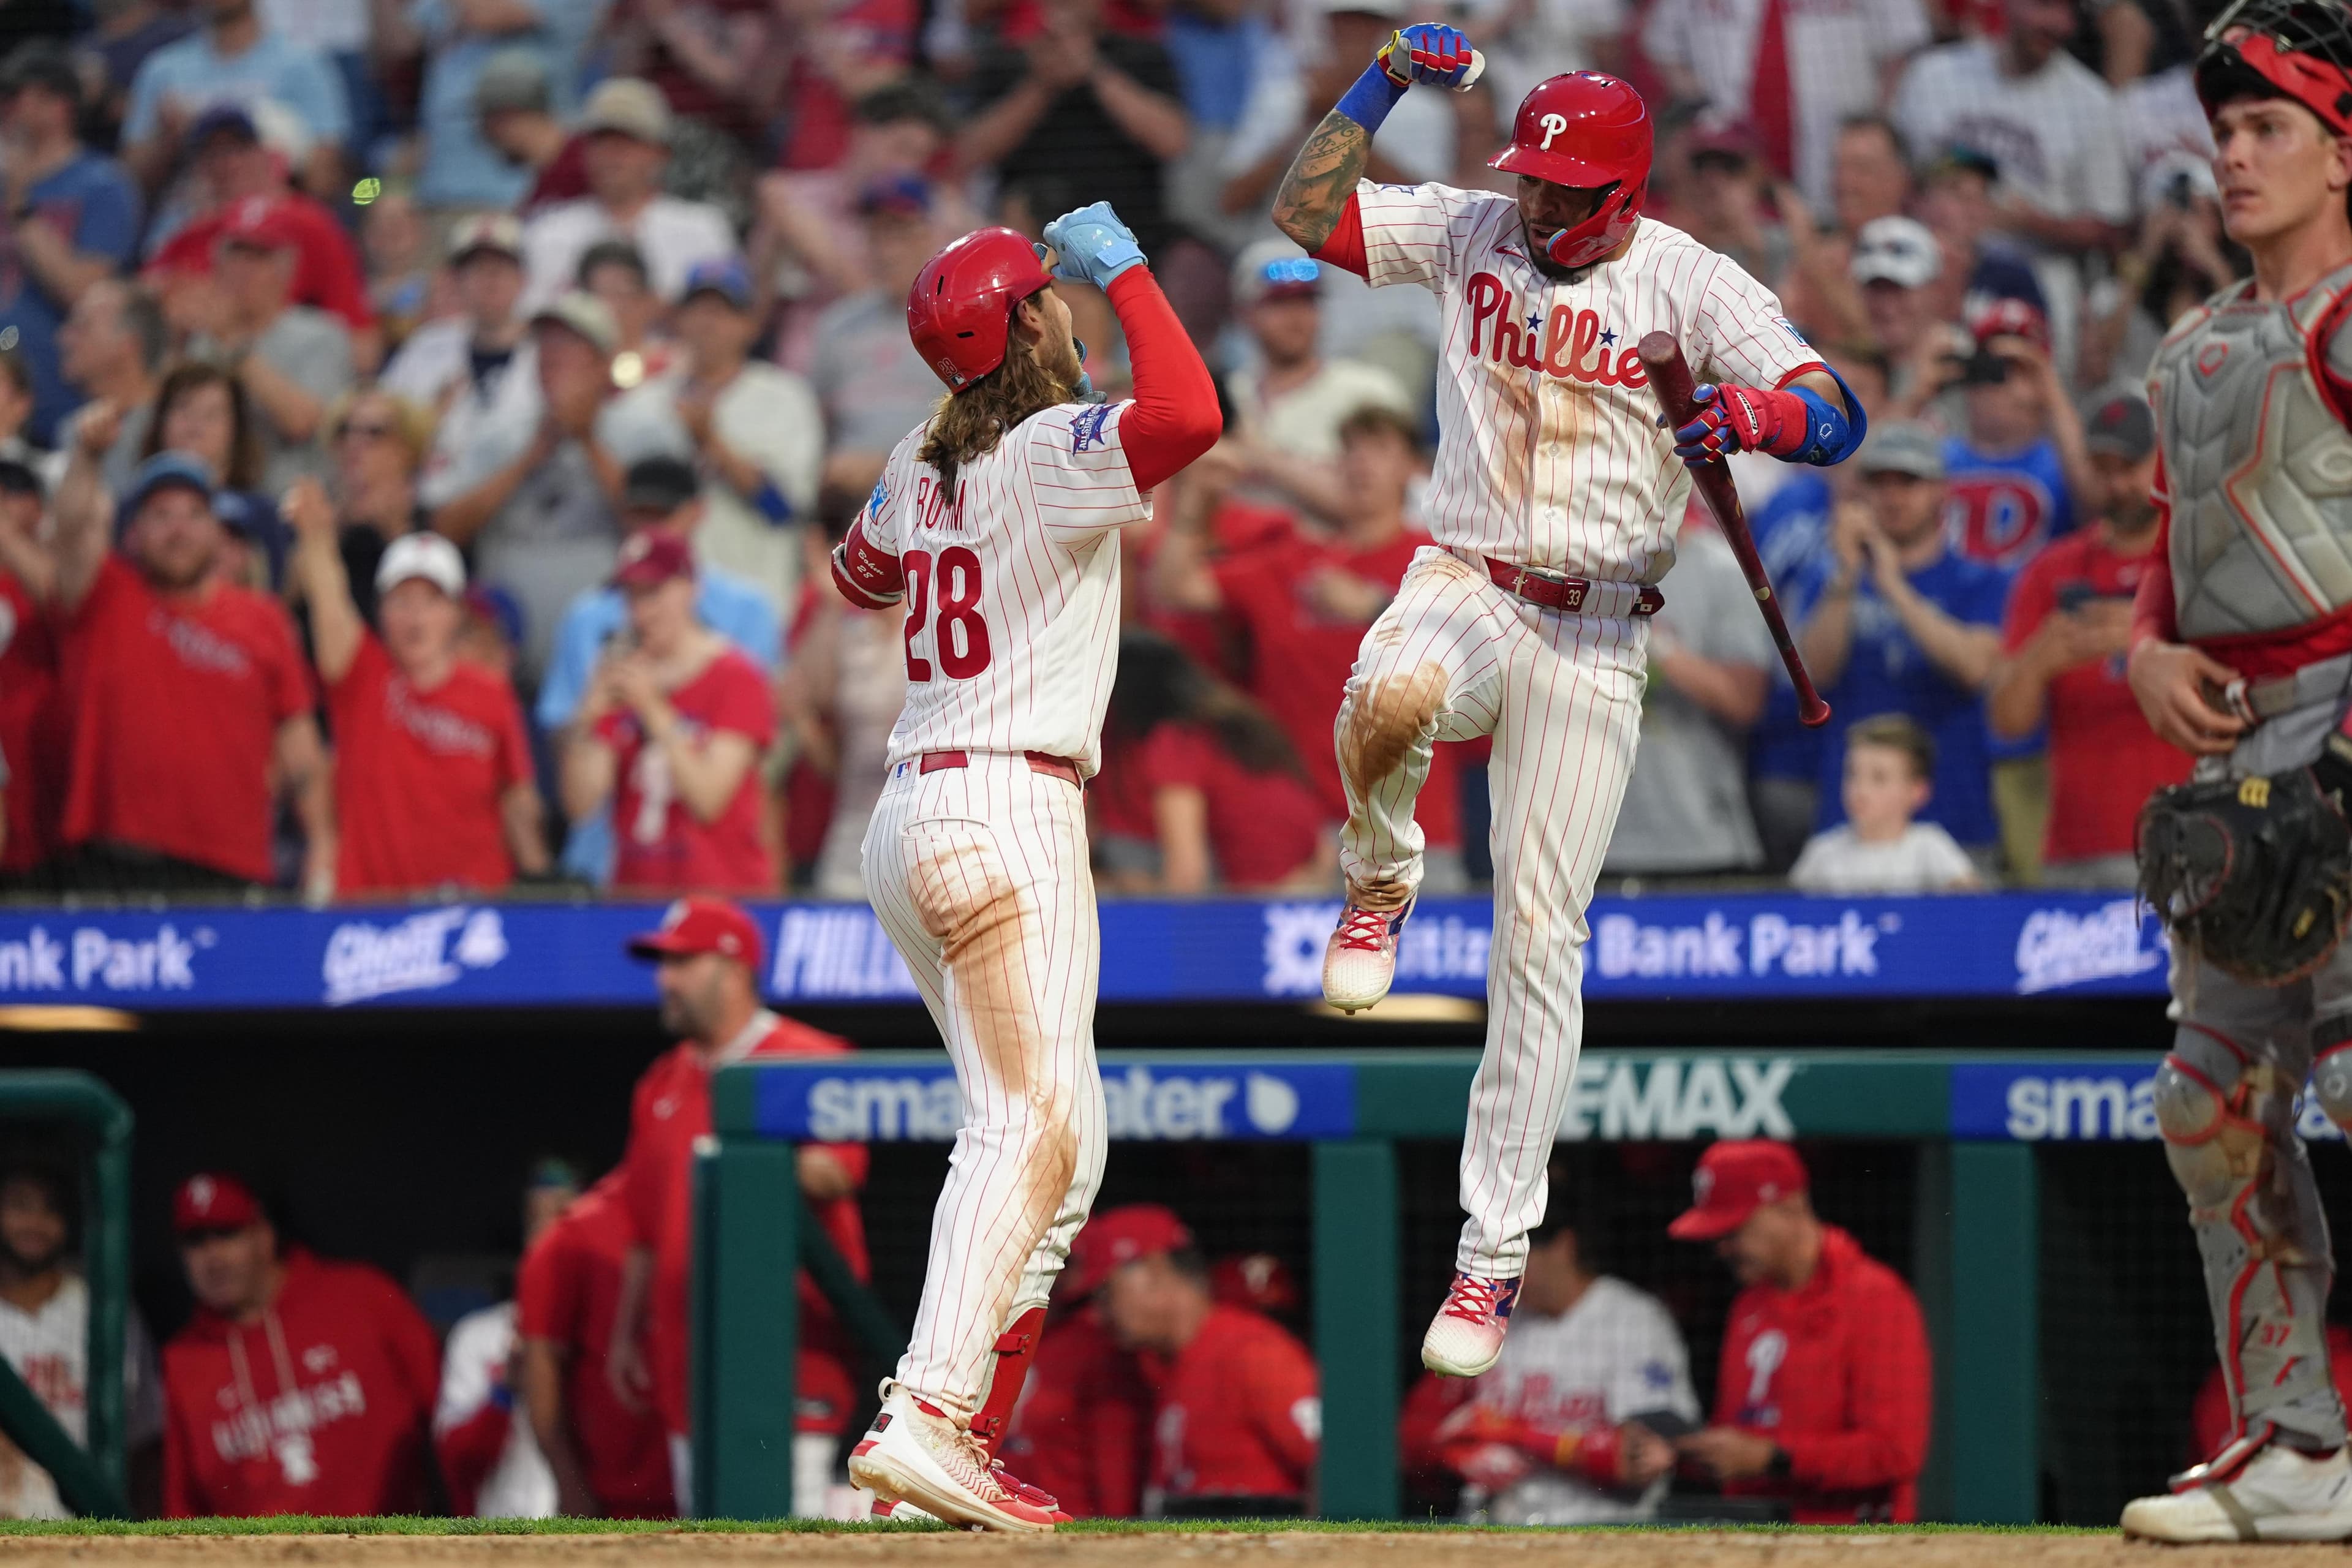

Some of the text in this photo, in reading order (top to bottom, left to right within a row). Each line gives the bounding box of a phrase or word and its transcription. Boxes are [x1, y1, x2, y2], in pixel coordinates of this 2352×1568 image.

[1540, 113, 1567, 151] P
[1466, 271, 1649, 390] Phillie
[857, 565, 873, 578] 28
[858, 548, 884, 575] Bohm
[902, 546, 991, 682] 28
[1567, 589, 1581, 606] 33
[0, 922, 195, 990] nk Park
[1597, 910, 1744, 978] Bank
[1749, 909, 1879, 978] Park
[807, 1066, 1236, 1140] smaater
[1556, 1058, 1797, 1139] EMAX
